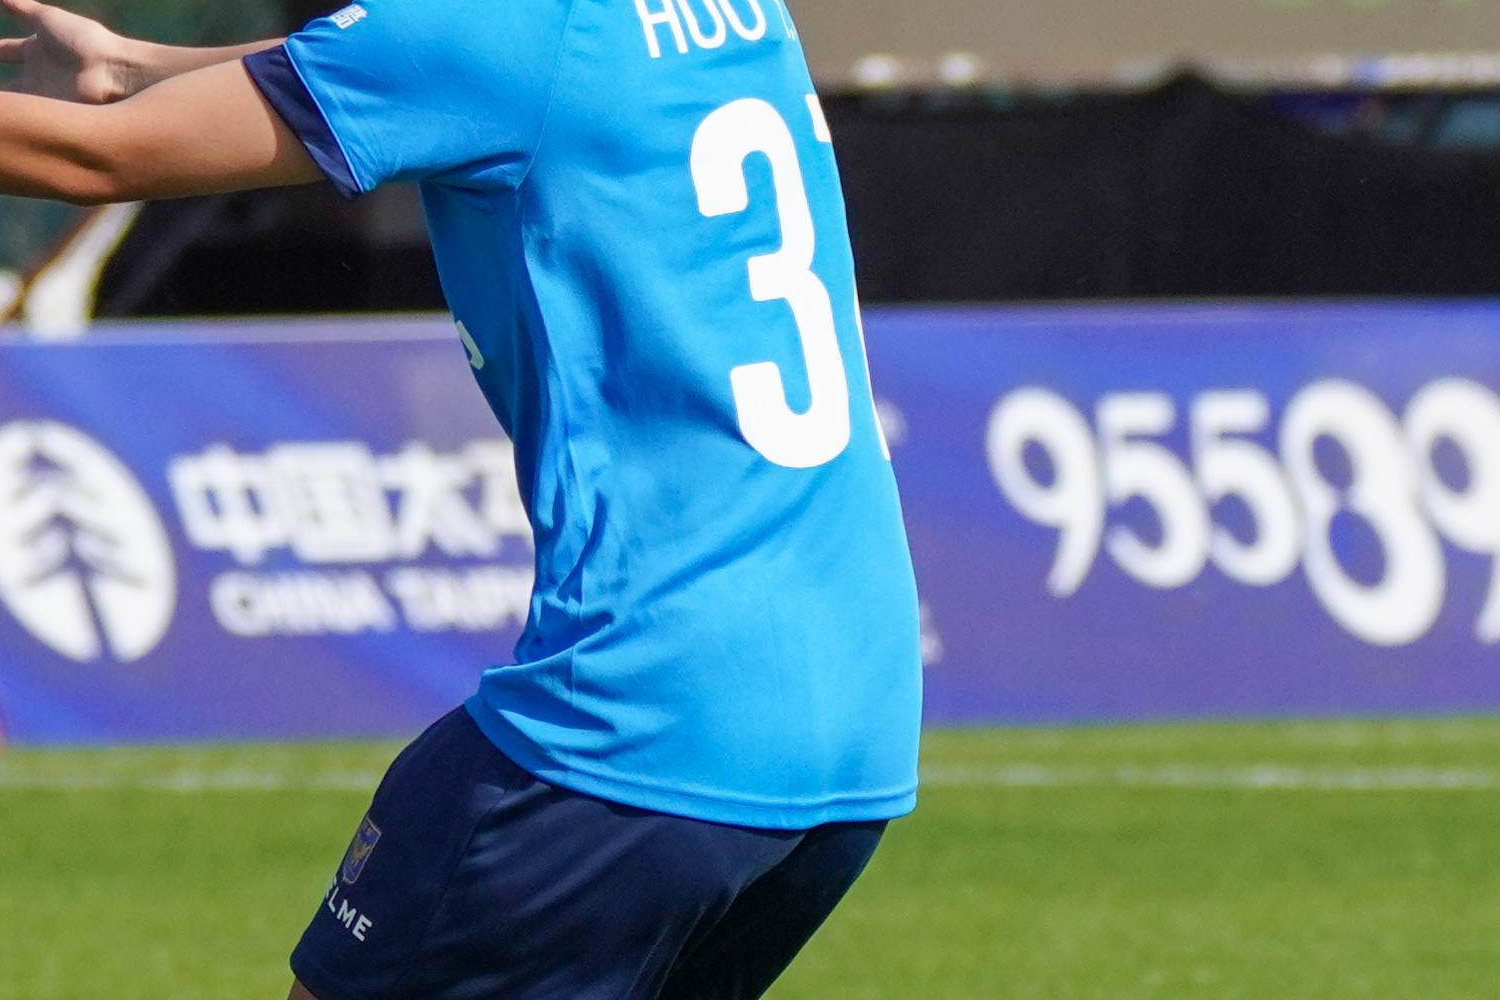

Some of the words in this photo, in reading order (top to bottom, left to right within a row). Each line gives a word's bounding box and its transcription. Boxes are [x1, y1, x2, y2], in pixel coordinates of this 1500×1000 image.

[690, 92, 891, 468] 3
[985, 376, 1500, 646] 95589
[209, 568, 398, 638] CHINA
[325, 876, 373, 942] LME
